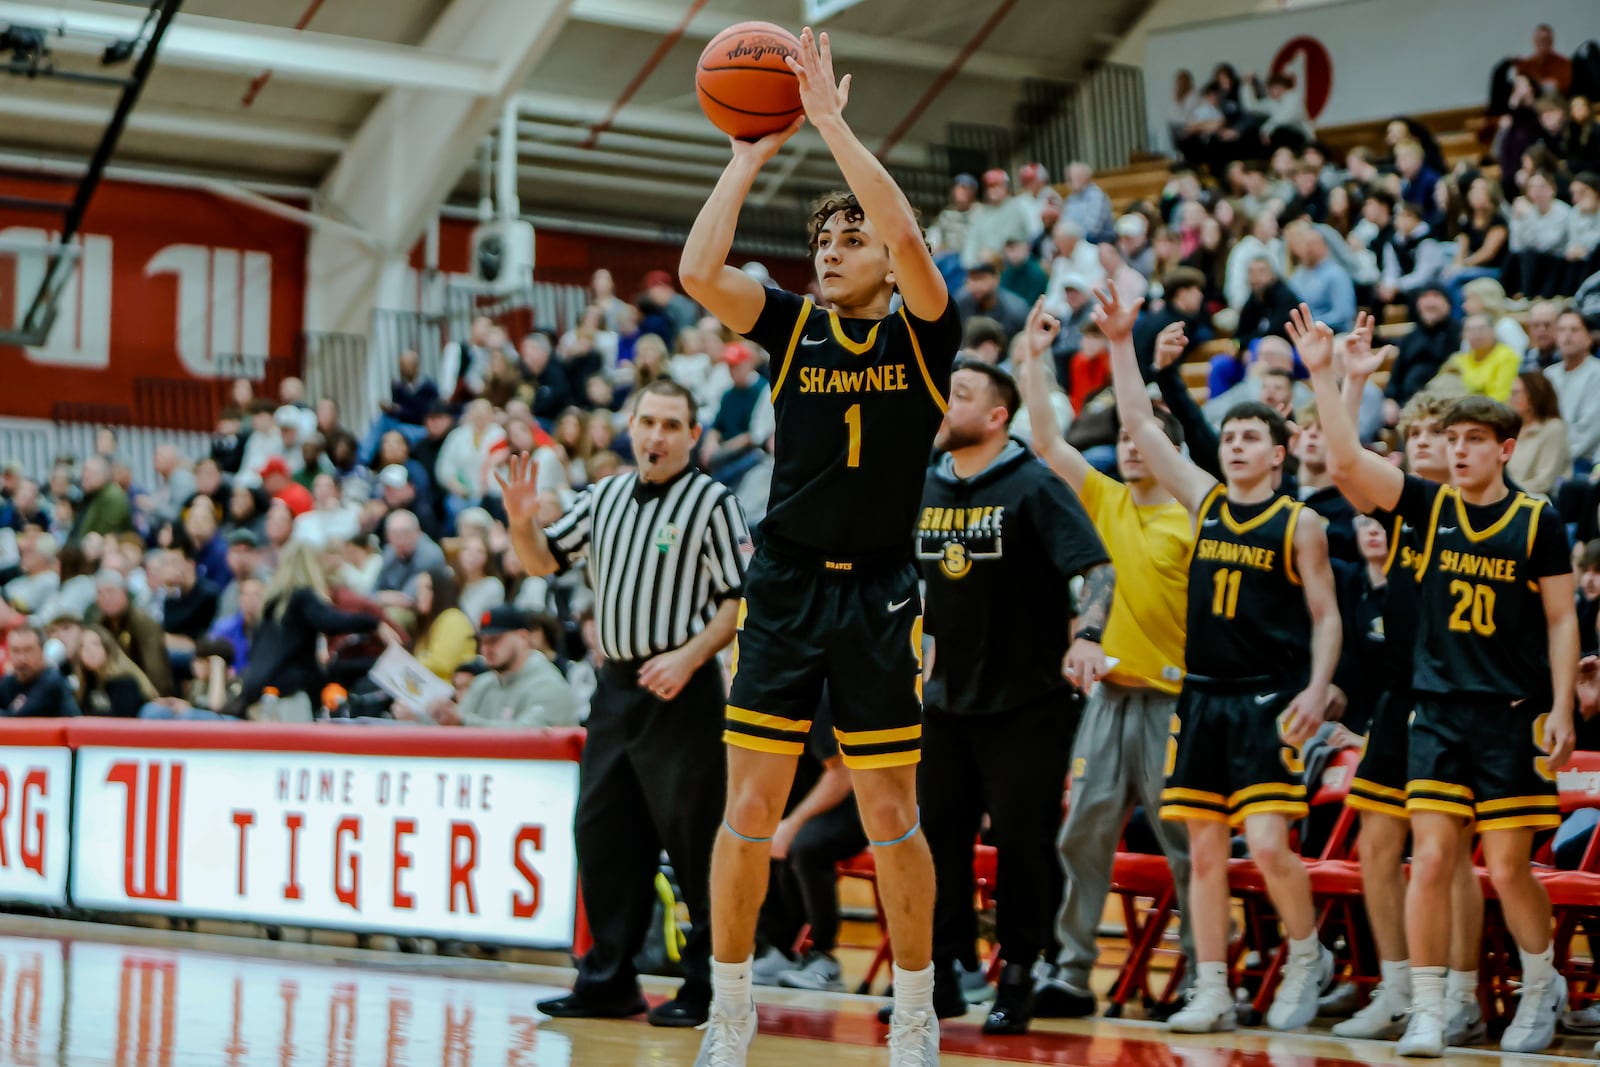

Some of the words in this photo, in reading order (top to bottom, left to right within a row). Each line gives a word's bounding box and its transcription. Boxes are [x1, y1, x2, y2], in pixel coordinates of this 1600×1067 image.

[800, 364, 909, 393] SHAWNEE
[844, 403, 862, 468] 1
[825, 560, 853, 571] BRAVES
[1197, 538, 1276, 572] SHAWNEE
[1211, 567, 1243, 620] 11
[1448, 578, 1497, 638] 20
[277, 768, 355, 804] HOME
[377, 771, 411, 807] OF
[436, 772, 494, 810] THE
[231, 810, 546, 919] TIGERS
